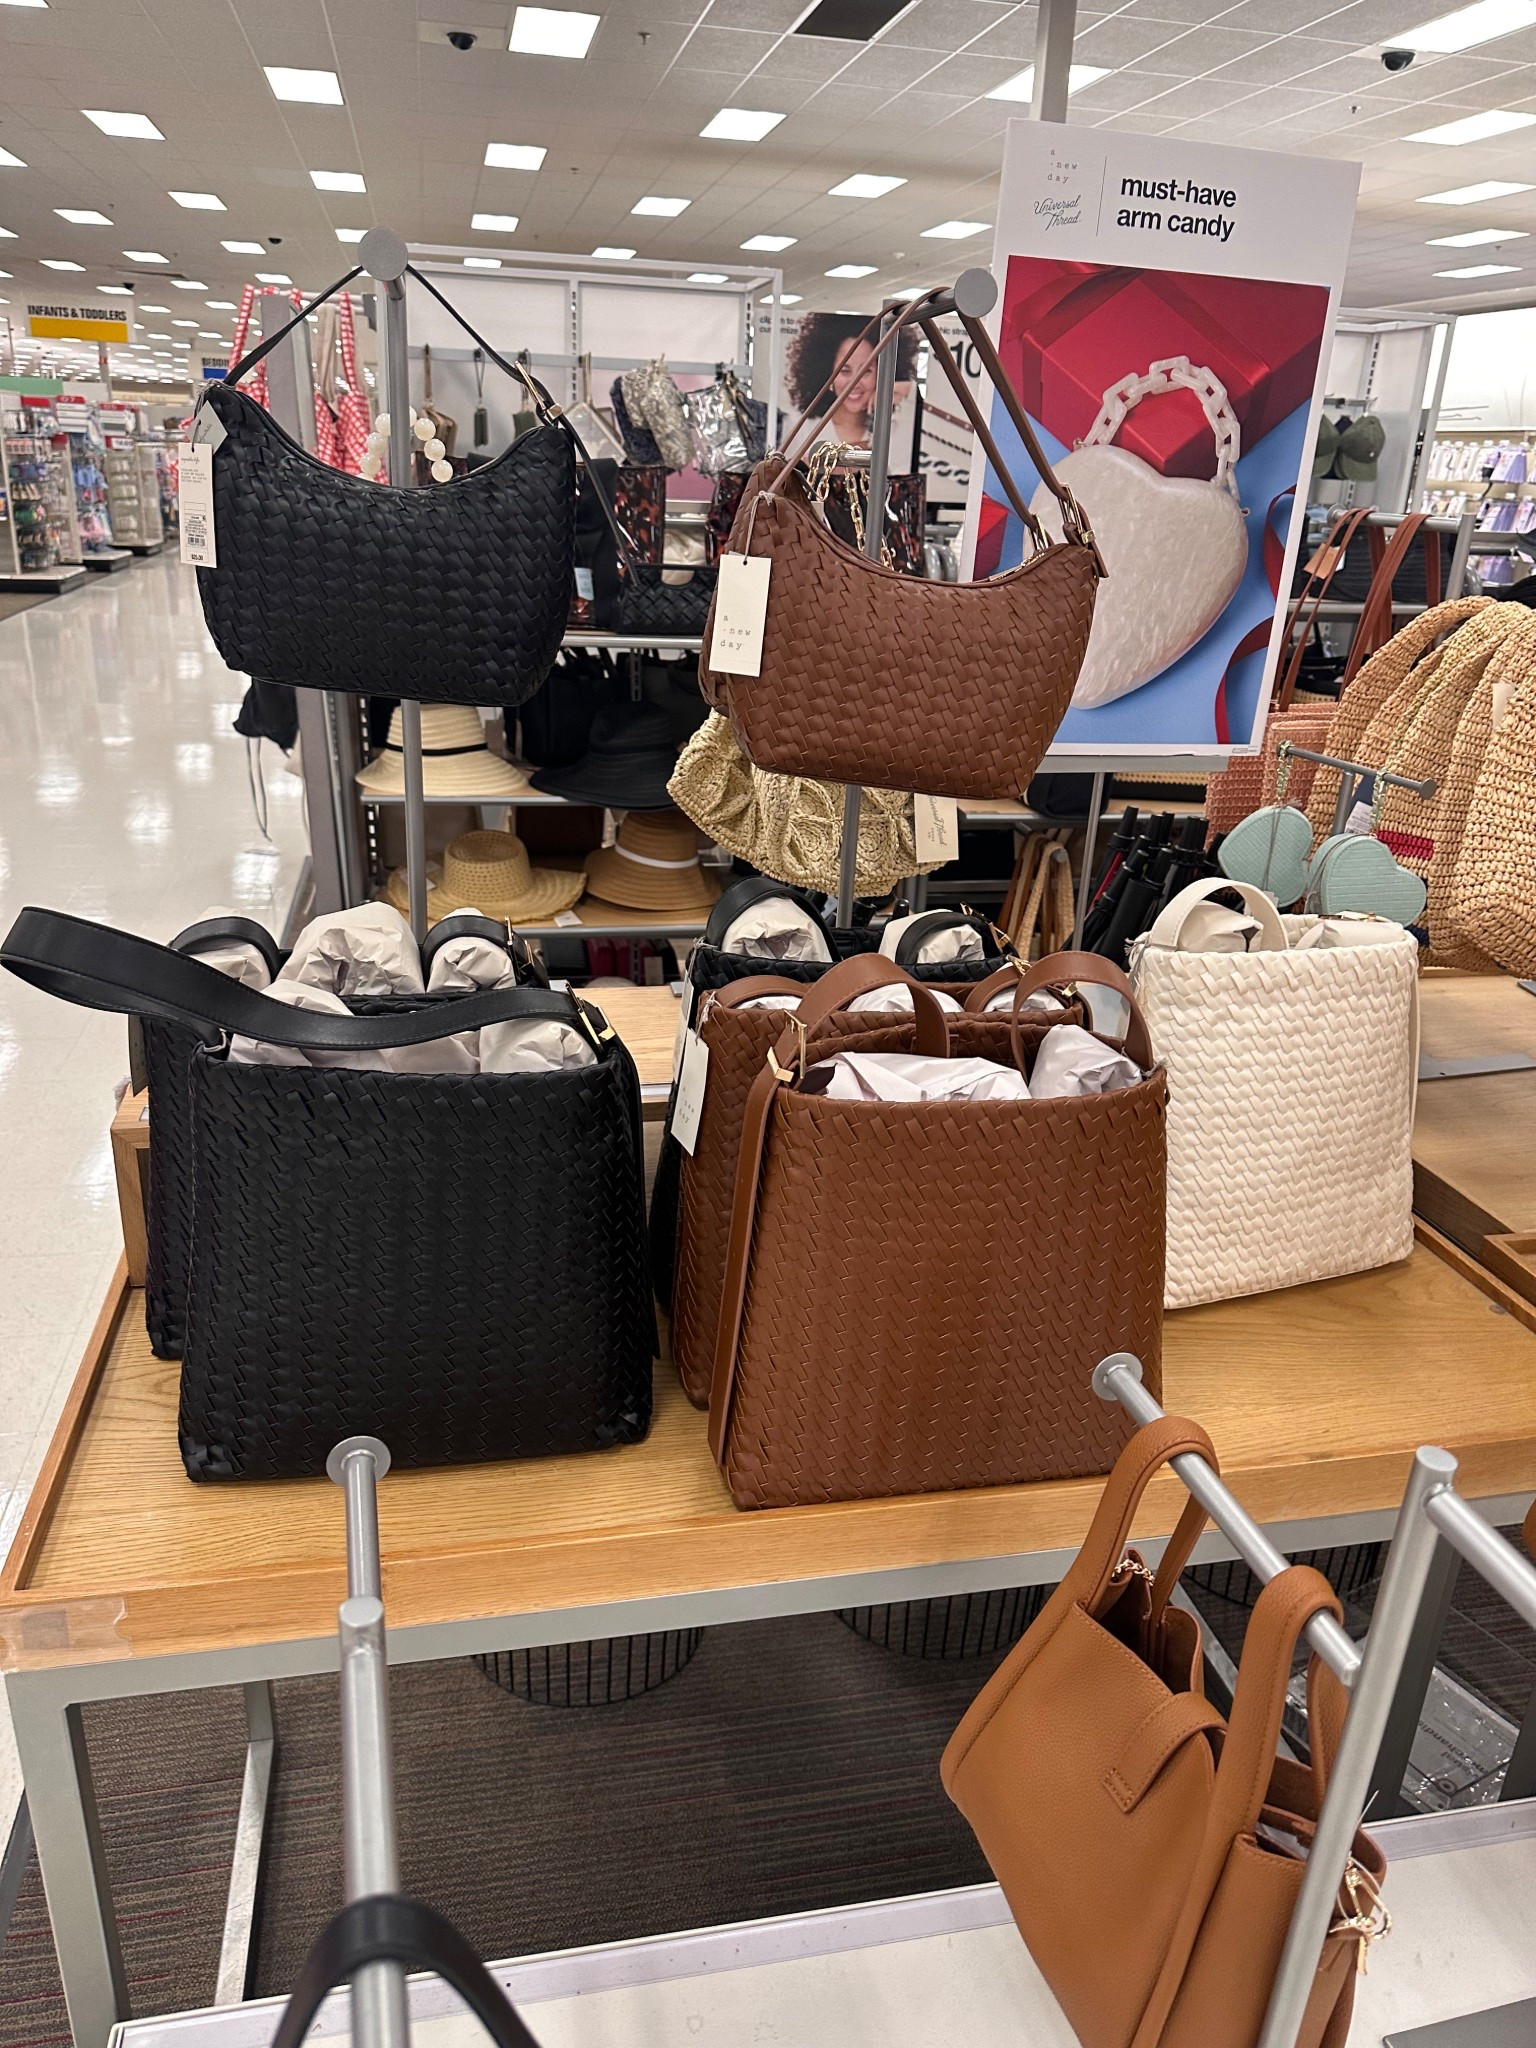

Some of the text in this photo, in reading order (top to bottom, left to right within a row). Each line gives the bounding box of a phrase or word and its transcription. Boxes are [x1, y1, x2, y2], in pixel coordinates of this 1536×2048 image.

[1047, 172, 1069, 184] day
[1120, 178, 1237, 208] must-have
[1033, 194, 1082, 215] Universal
[1042, 209, 1082, 232] Thread
[1116, 208, 1236, 243] arm candy
[28, 305, 127, 321] INFANTS & TODDLERS
[720, 639, 742, 650] day
